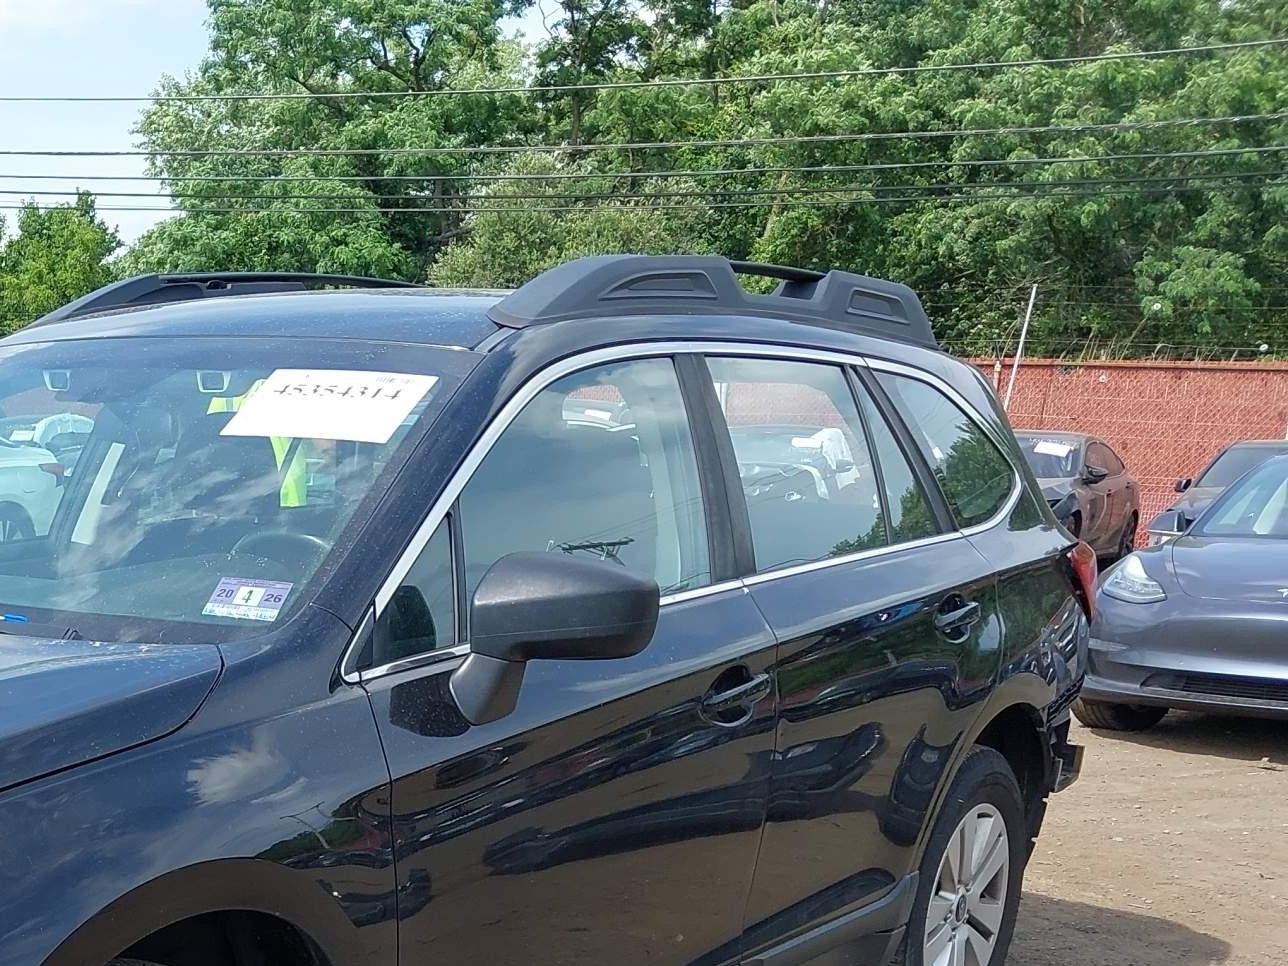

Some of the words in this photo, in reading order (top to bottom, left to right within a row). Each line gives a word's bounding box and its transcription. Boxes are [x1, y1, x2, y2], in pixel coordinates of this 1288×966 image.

[216, 588, 234, 598] 20
[241, 589, 254, 603] 4
[263, 593, 283, 603] 26
